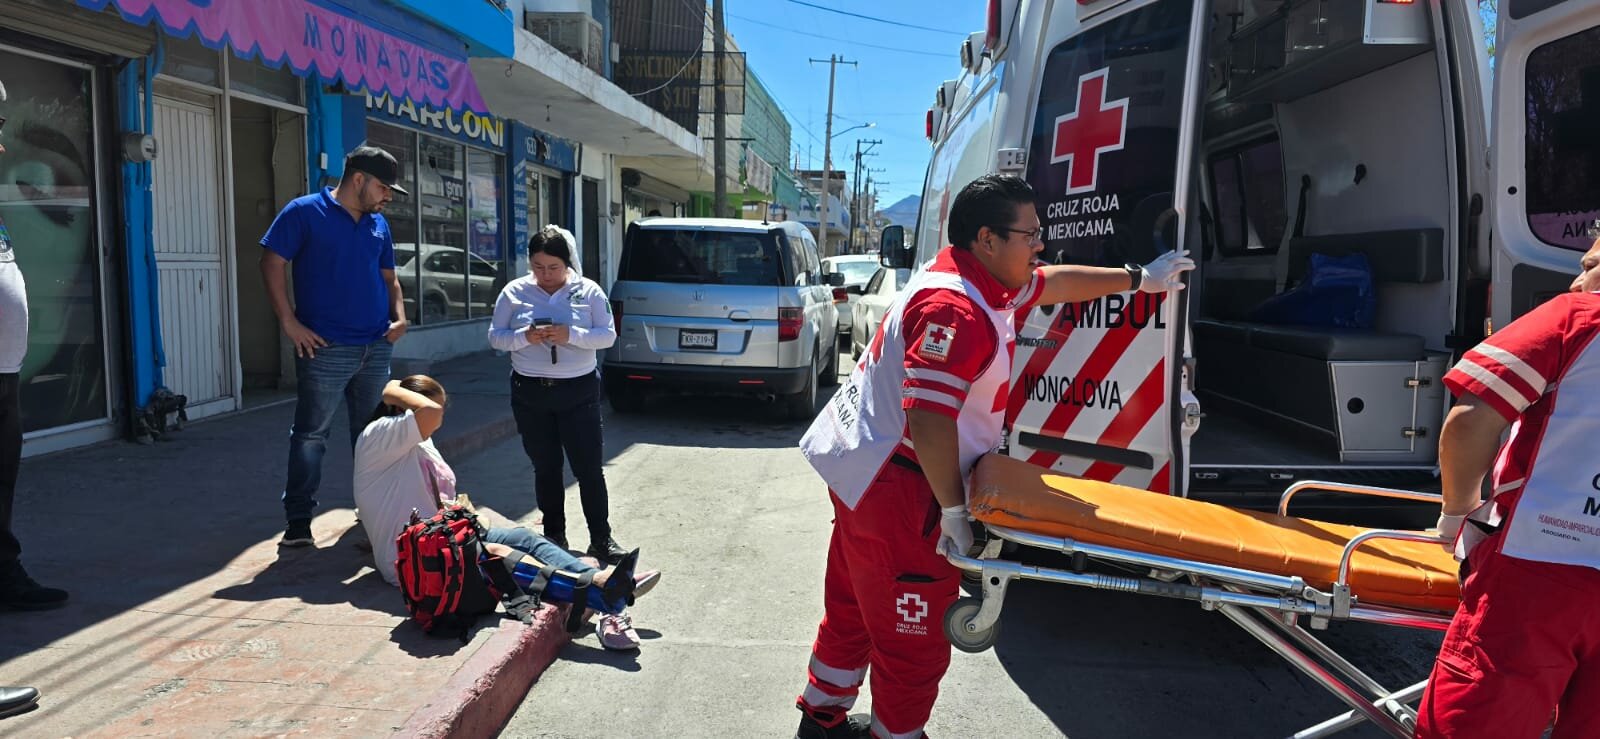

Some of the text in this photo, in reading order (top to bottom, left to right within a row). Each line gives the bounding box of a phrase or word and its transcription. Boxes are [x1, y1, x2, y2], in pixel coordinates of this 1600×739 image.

[303, 12, 450, 91] MONADAS
[366, 91, 504, 147] MARCONI
[1047, 193, 1120, 219] CRUZ ROJA
[1047, 217, 1114, 241] MEXICANA
[1024, 373, 1122, 411] MONCLOVA
[896, 627, 928, 635] MEXICANA
